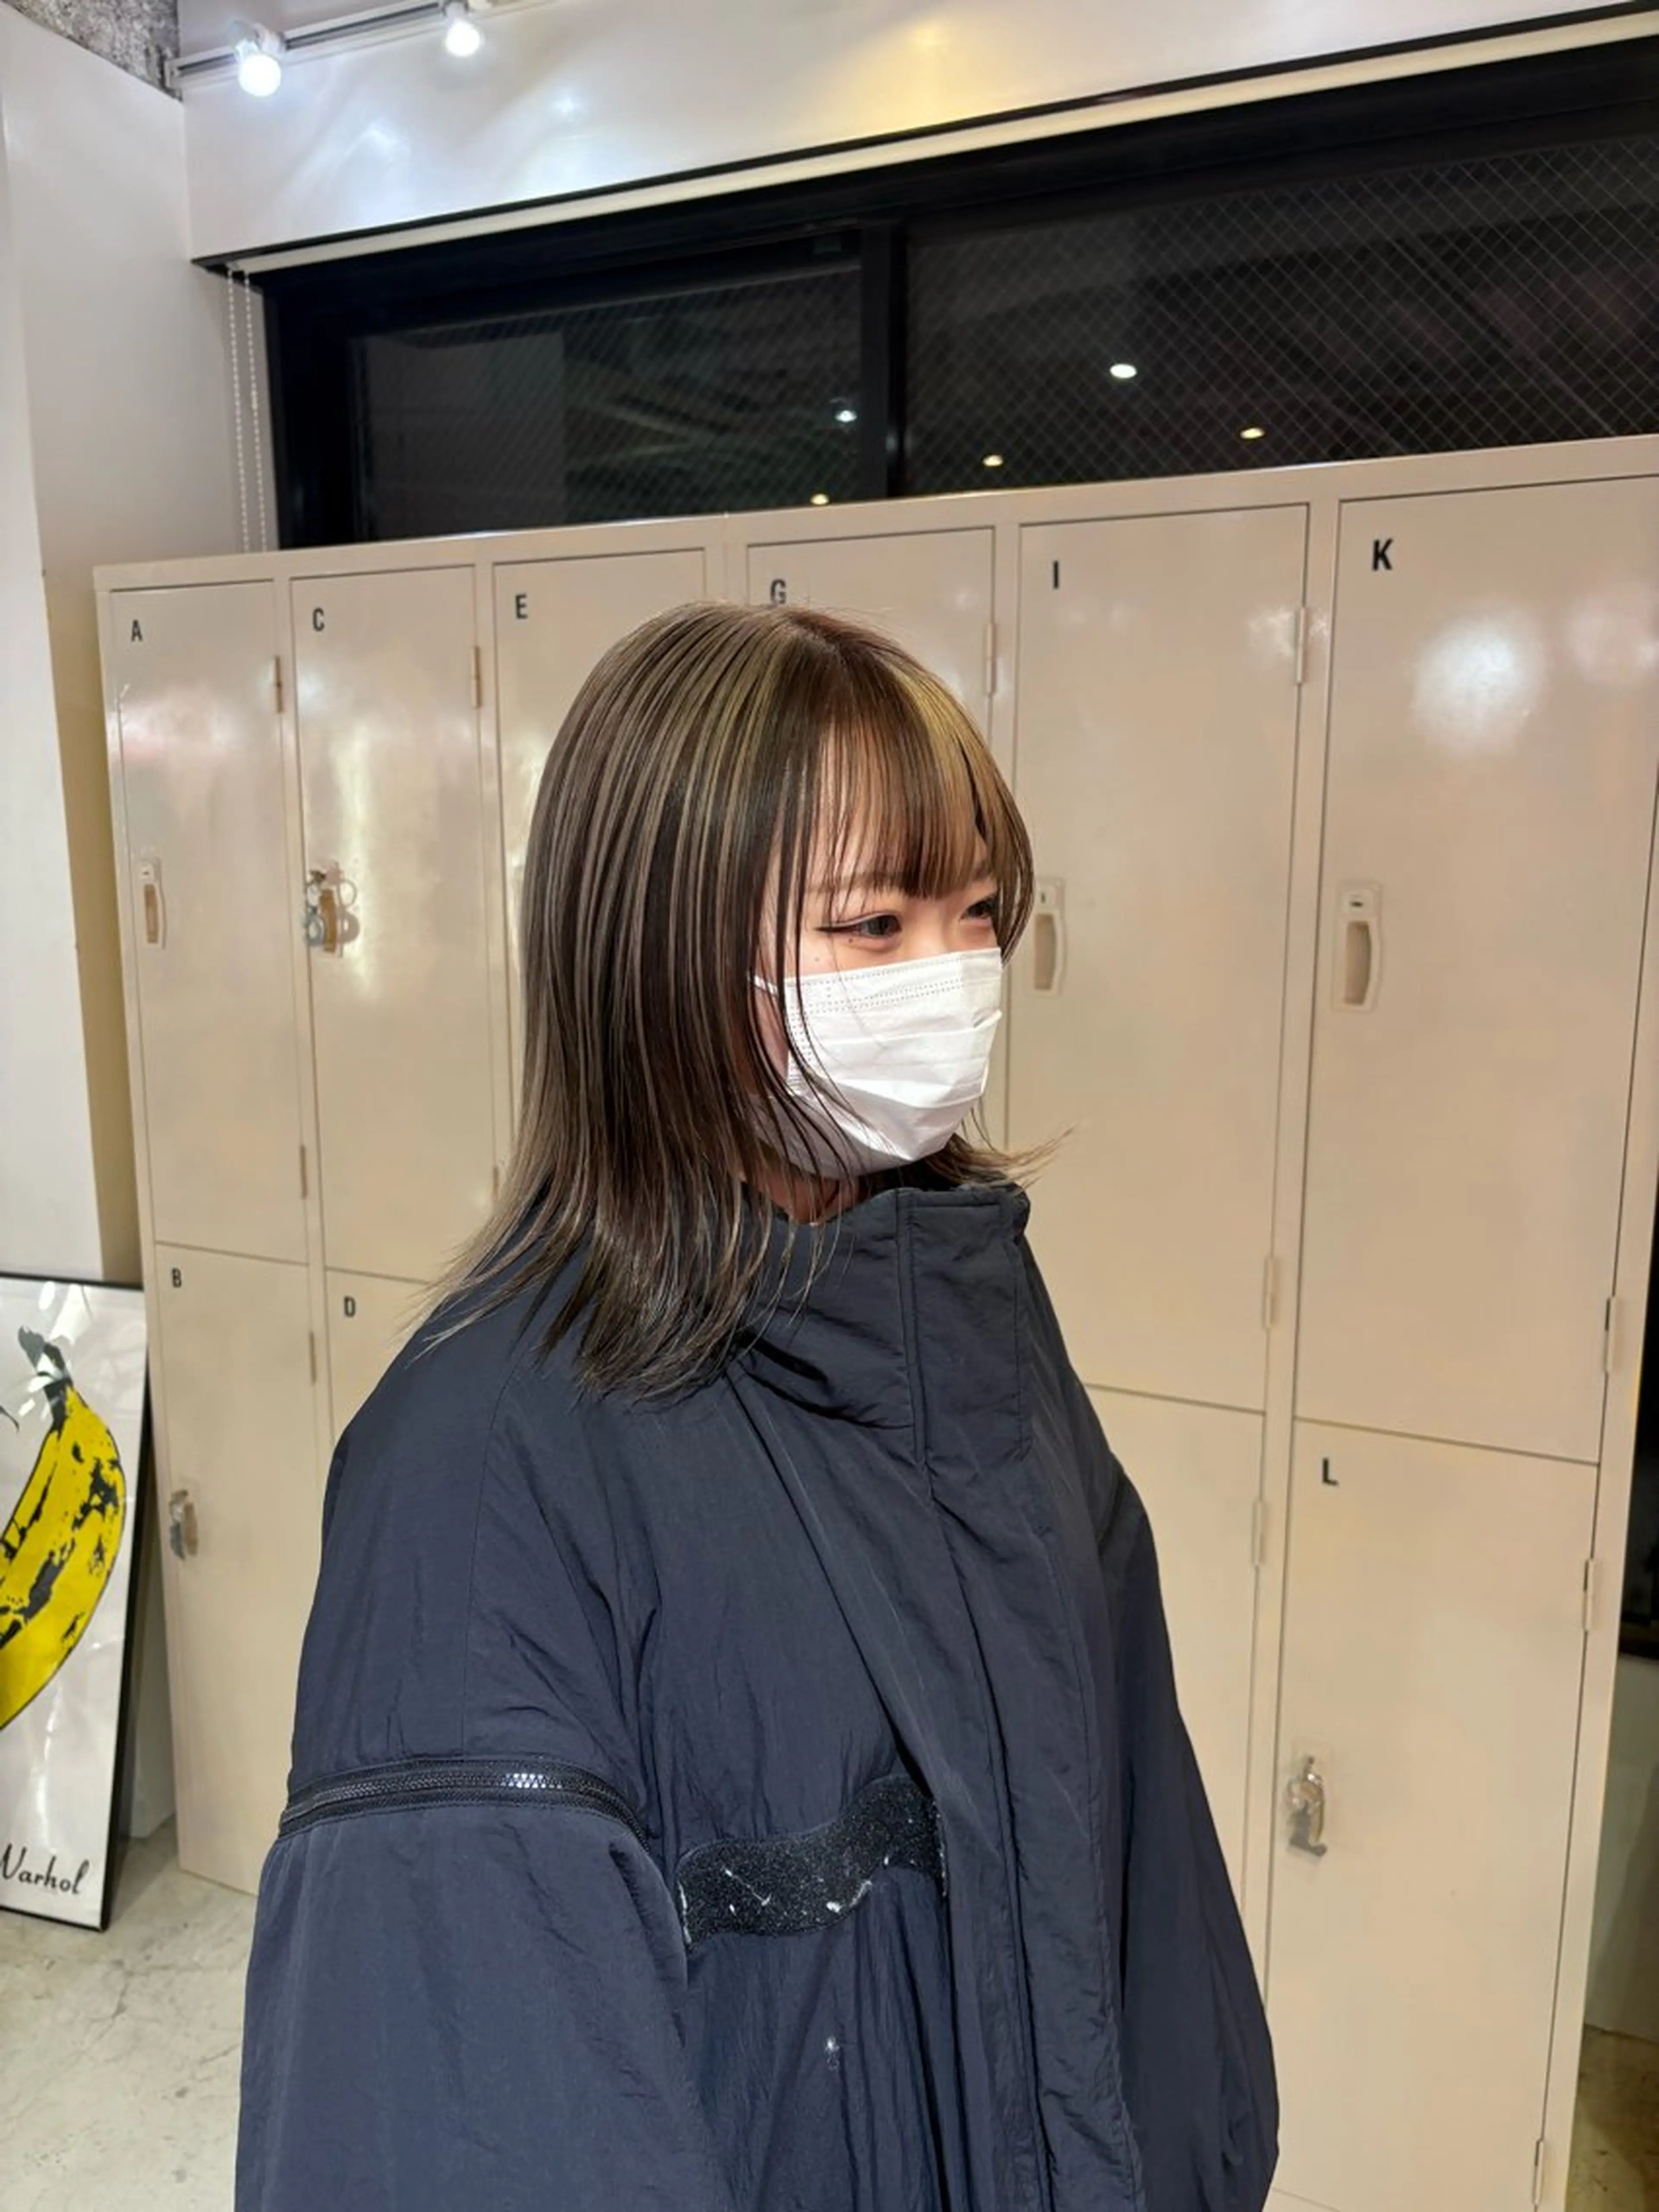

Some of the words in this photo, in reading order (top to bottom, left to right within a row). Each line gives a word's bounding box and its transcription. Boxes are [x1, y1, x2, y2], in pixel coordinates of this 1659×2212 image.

[1372, 538, 1393, 572] K
[1052, 560, 1059, 589] I
[770, 578, 787, 604] G
[312, 607, 325, 632] C
[515, 594, 528, 620] E
[131, 620, 143, 642] A
[172, 1268, 182, 1288] B
[343, 1296, 356, 1317] D
[1322, 1458, 1338, 1486] L
